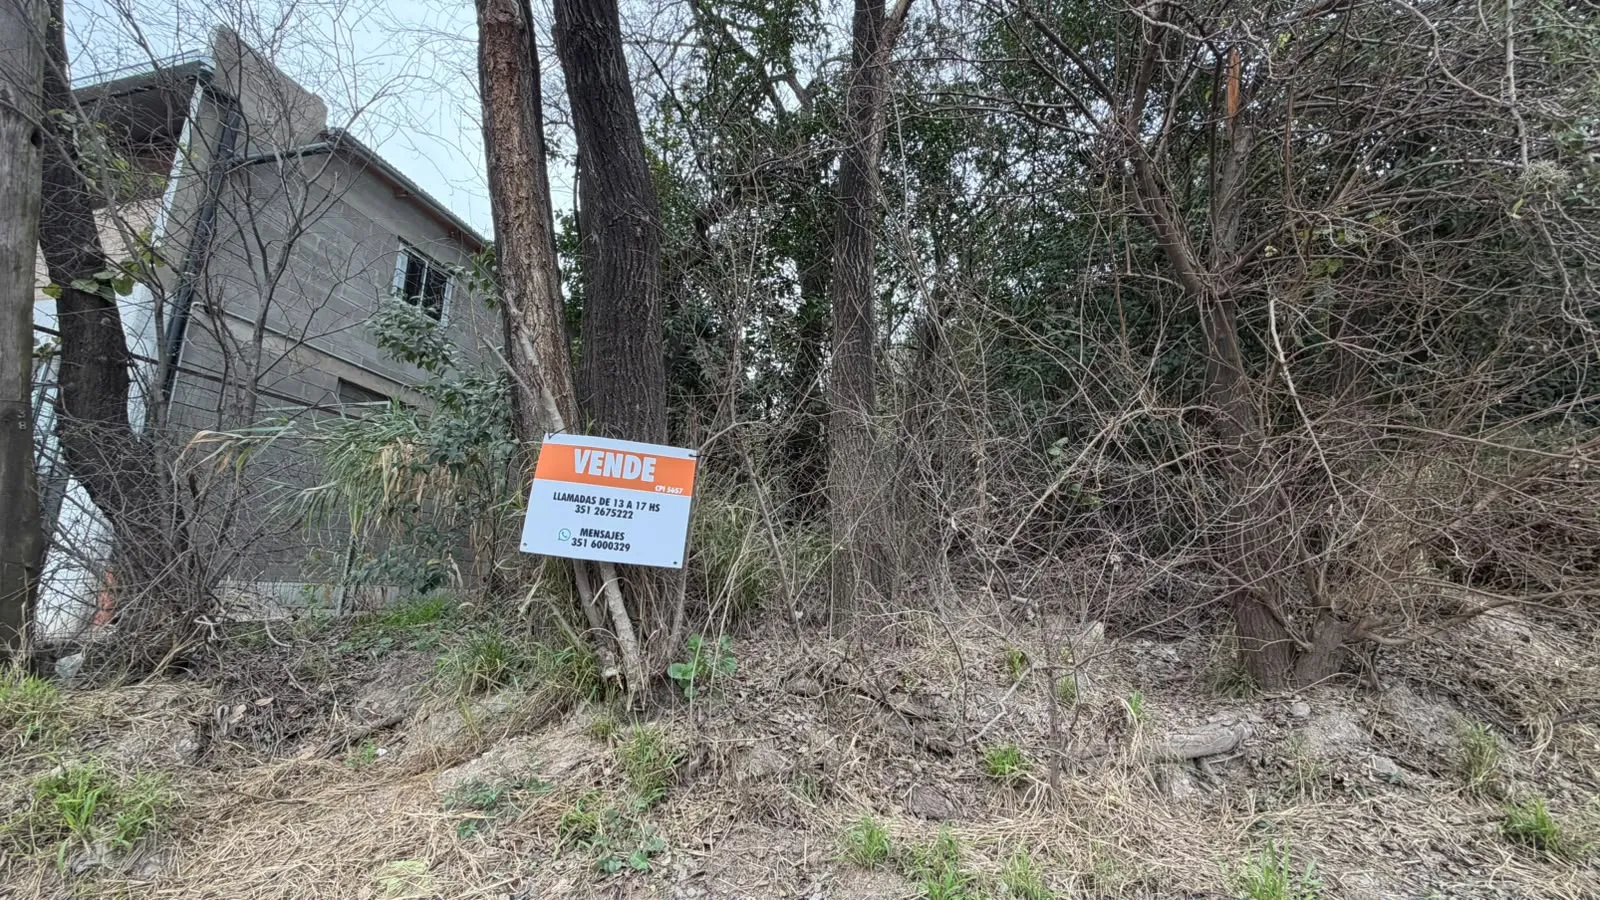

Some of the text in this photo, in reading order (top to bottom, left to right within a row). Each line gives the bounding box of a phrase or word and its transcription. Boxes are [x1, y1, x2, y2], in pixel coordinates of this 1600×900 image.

[574, 449, 657, 482] VENDE
[655, 485, 666, 493] CPI
[553, 492, 660, 512] LLAMADAS DE 13 A 17 HS
[575, 505, 633, 519] 351 2675222
[580, 528, 625, 540] MENSAJES
[571, 538, 631, 552] 351 6000329
